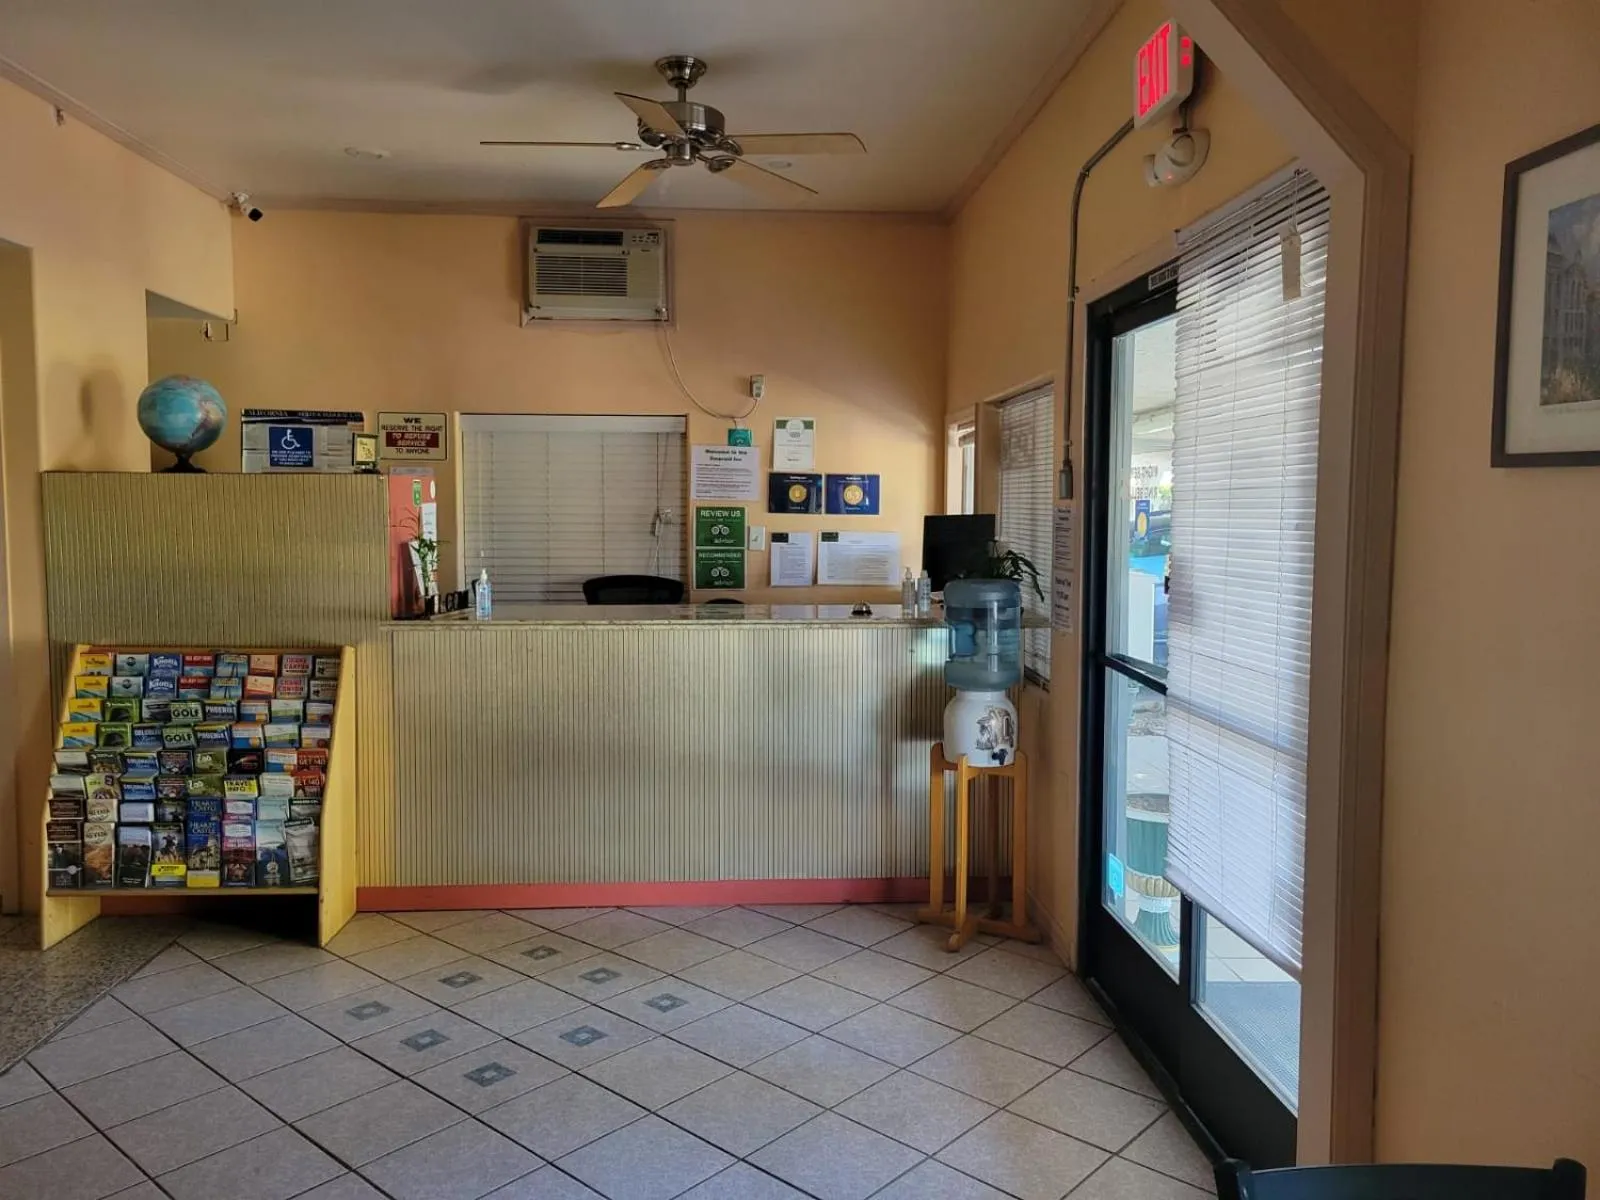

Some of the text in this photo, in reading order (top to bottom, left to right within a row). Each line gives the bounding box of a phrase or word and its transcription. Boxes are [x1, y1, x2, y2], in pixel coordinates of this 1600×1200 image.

[1137, 22, 1171, 119] EXIT
[172, 708, 199, 718] GOLF
[164, 733, 193, 743] GOLF
